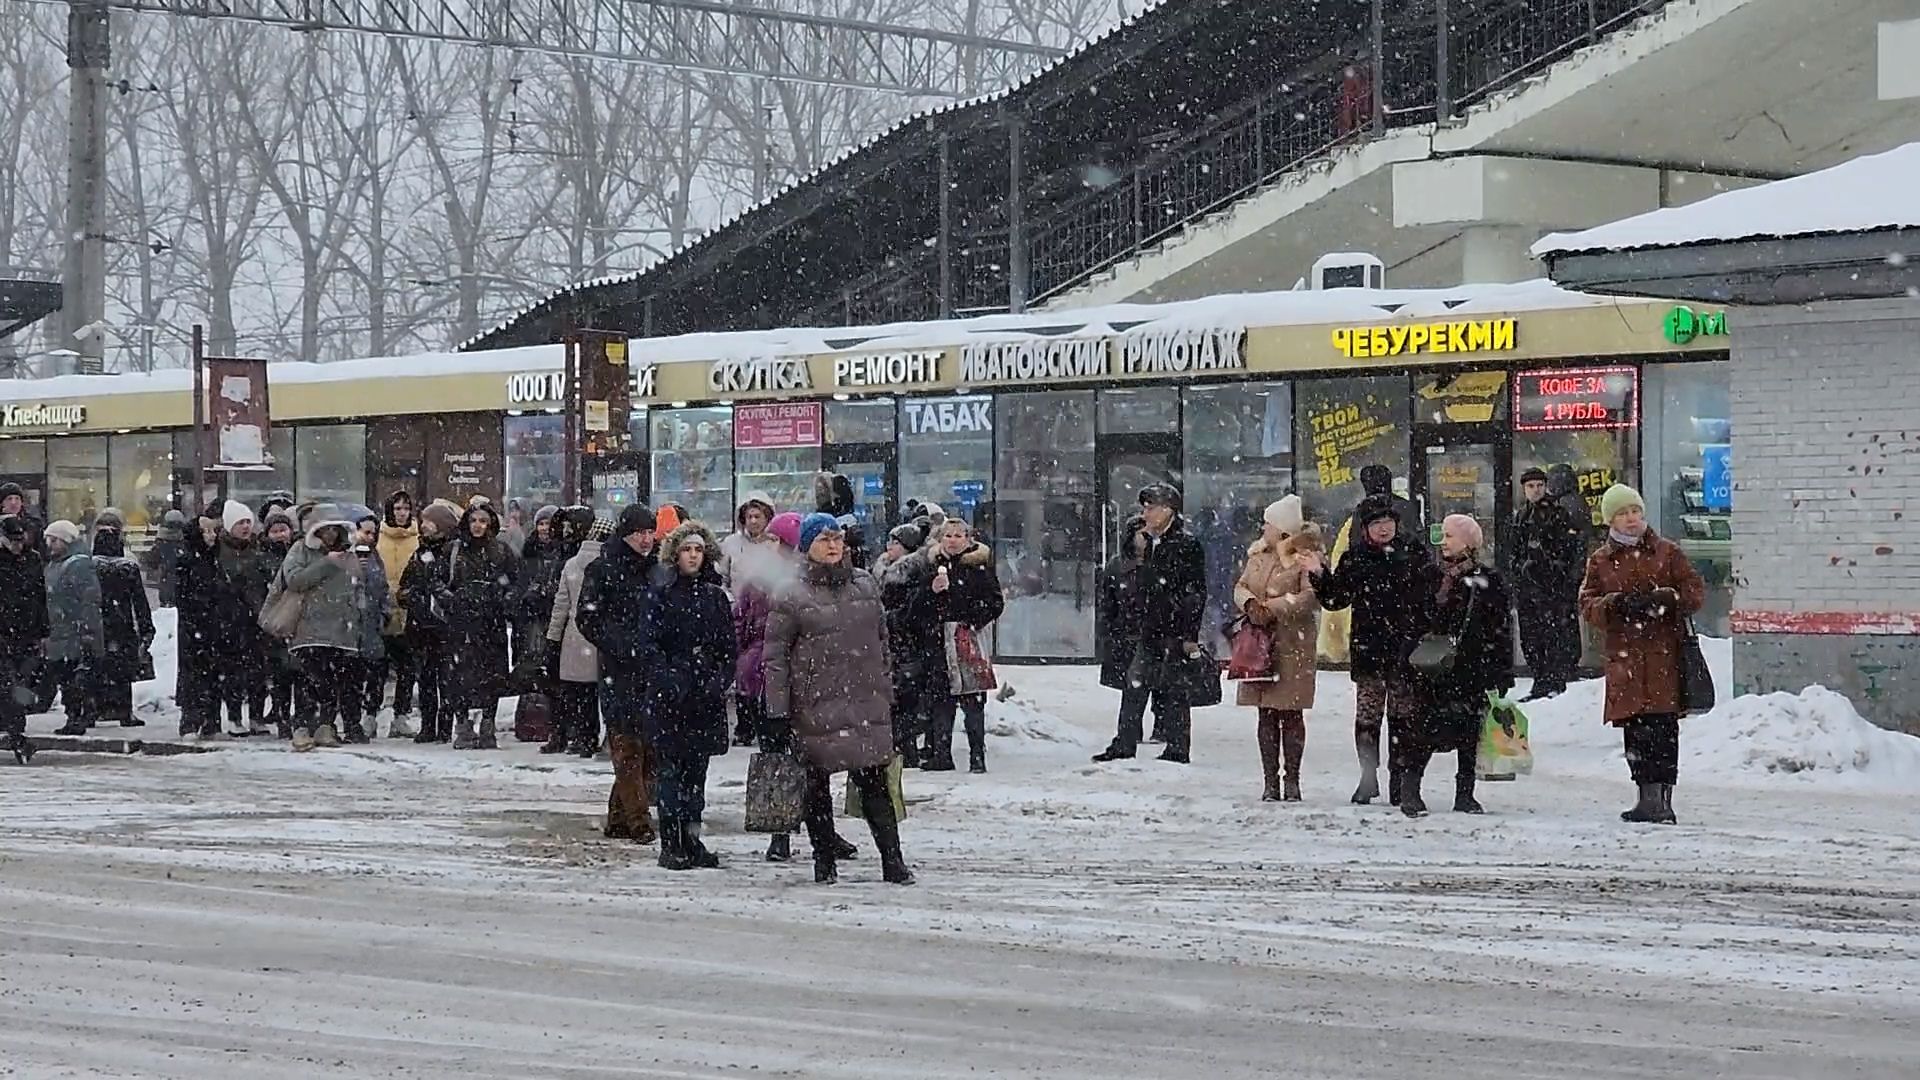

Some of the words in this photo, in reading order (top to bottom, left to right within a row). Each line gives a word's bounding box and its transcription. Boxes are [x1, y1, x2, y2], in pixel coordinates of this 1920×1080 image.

[1332, 318, 1516, 358] ЧЕБУРЕКМИ
[959, 335, 1109, 382] ИВАНОВСКИЙ
[1120, 327, 1247, 372] ТРИКОТАЖ
[708, 356, 813, 393] СКУПКА
[833, 351, 944, 387] РЕМОНТ
[504, 374, 546, 402] 1000
[1540, 378, 1585, 395] КОФЕ
[1586, 376, 1607, 394] ЗА
[3, 404, 85, 429] Хлебница
[779, 405, 815, 418] РЕМОНТ
[905, 402, 993, 434] ТАБАК
[1544, 404, 1554, 420] 1
[1557, 402, 1607, 420] РУБЛЬ
[1320, 466, 1354, 489] РЕК
[1711, 486, 1731, 498] YO
